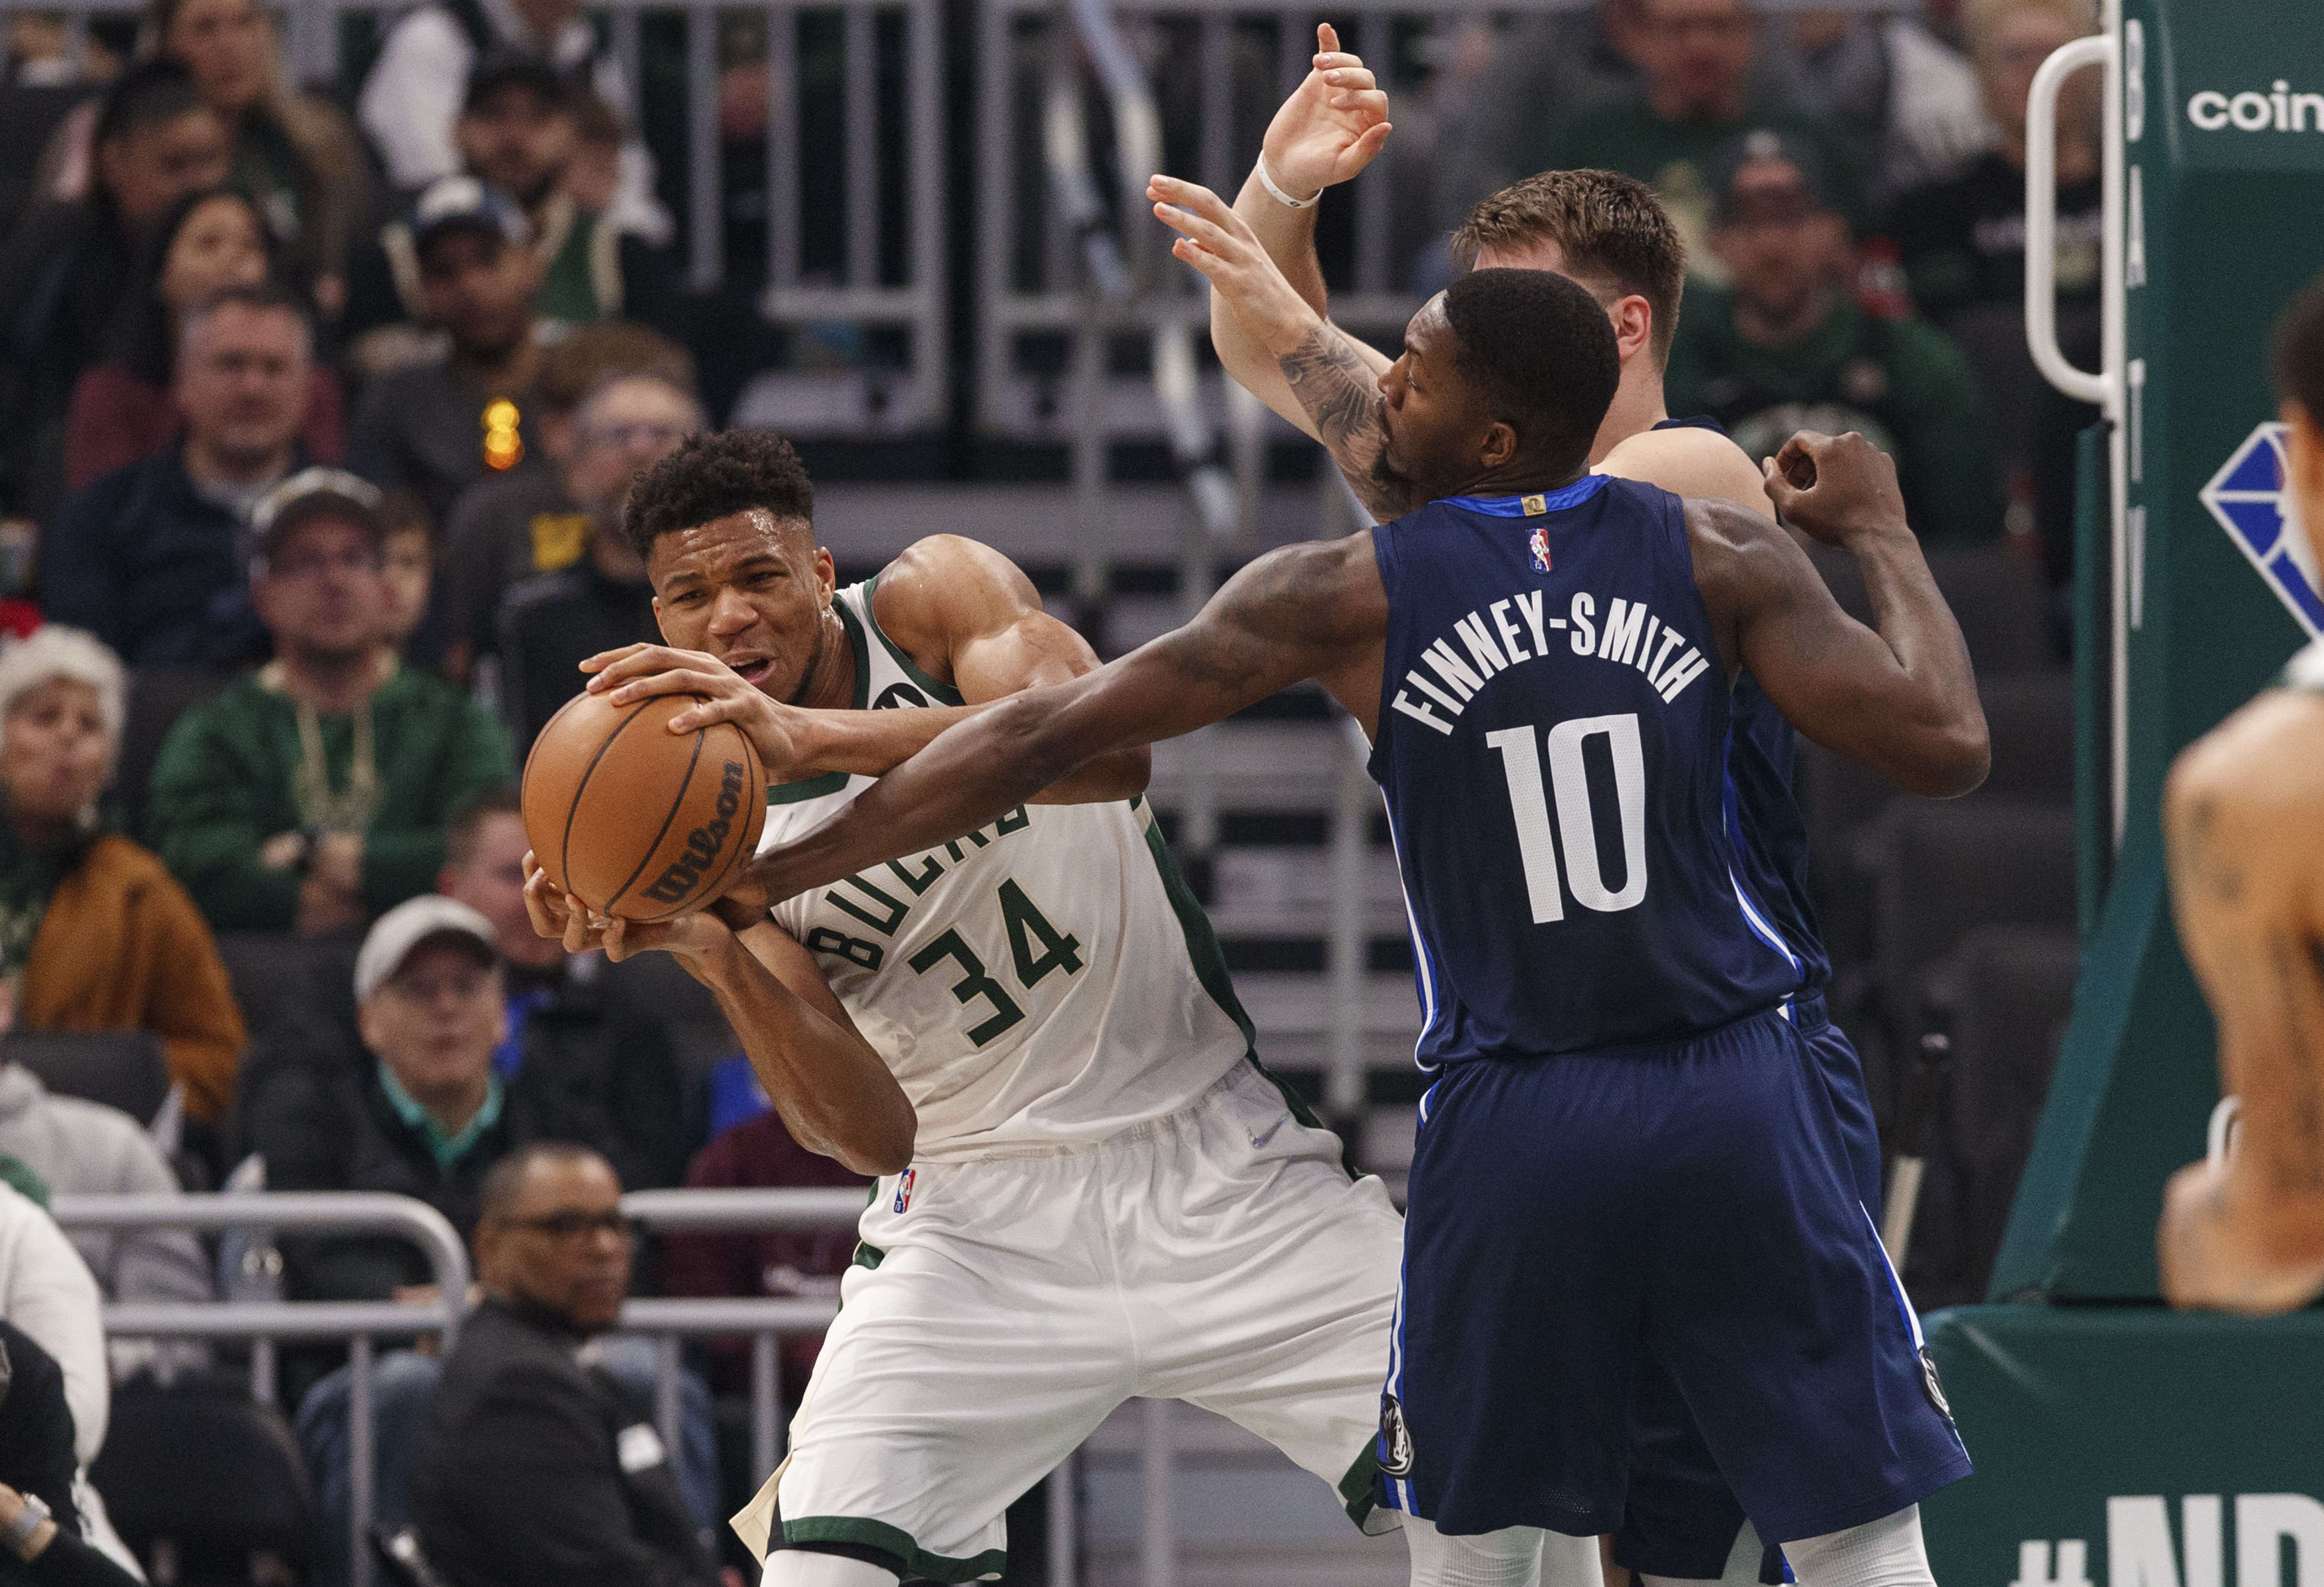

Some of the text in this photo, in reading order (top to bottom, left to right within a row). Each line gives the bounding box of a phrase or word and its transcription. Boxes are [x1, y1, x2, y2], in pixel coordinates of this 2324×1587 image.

[1391, 590, 1709, 735] FINNEY-SMITH
[639, 759, 744, 903] Wilson
[1486, 713, 1648, 924] 10
[907, 877, 1084, 1048] 34
